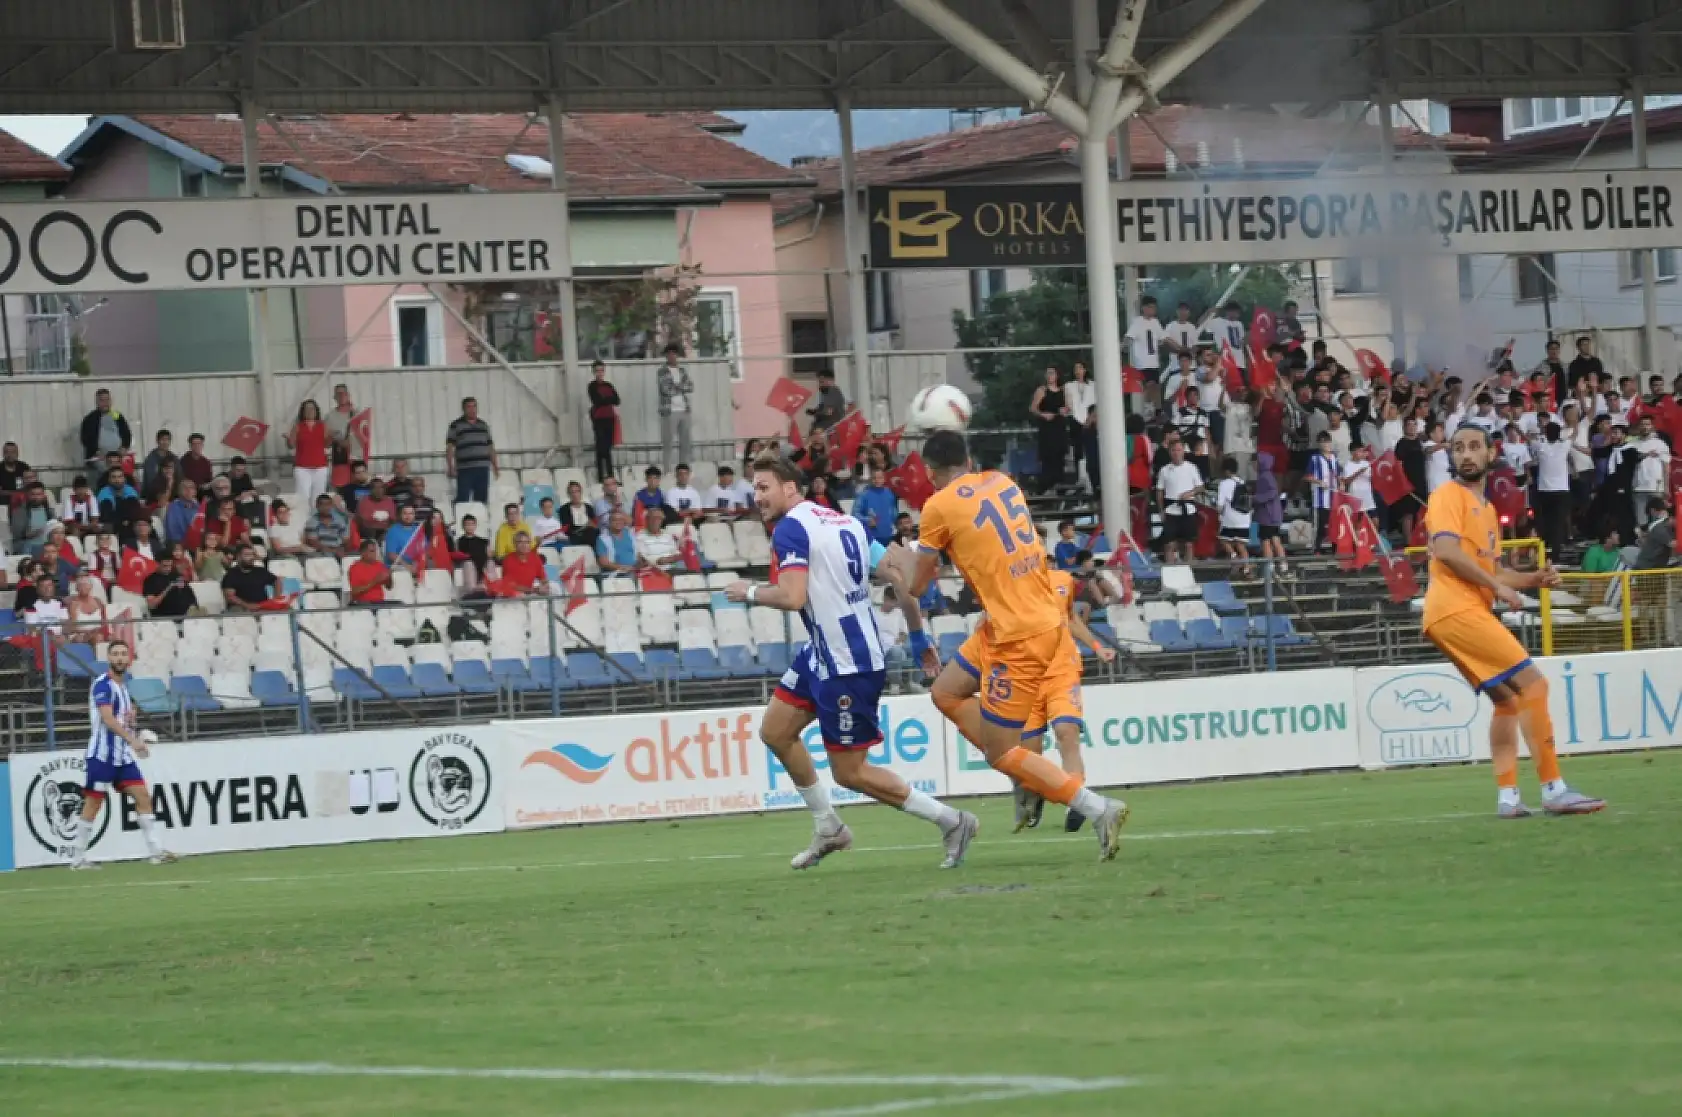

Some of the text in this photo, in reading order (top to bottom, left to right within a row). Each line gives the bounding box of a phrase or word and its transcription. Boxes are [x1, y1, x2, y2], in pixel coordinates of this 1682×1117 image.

[296, 203, 441, 239] DENTAL
[974, 201, 1085, 237] ORKA
[1117, 184, 1382, 242] FETHİYESPOR'A
[1580, 174, 1674, 231] DİLER
[186, 240, 550, 281] OPERATION CENTER
[994, 242, 1071, 255] HOTELS
[973, 485, 1034, 555] 15
[839, 529, 863, 585] 9
[987, 676, 1012, 700] 15
[424, 733, 474, 750] BAVYERA
[1102, 702, 1347, 748] CONSTRUCTION
[624, 713, 753, 784] aktif
[121, 774, 308, 832] BAVYERA
